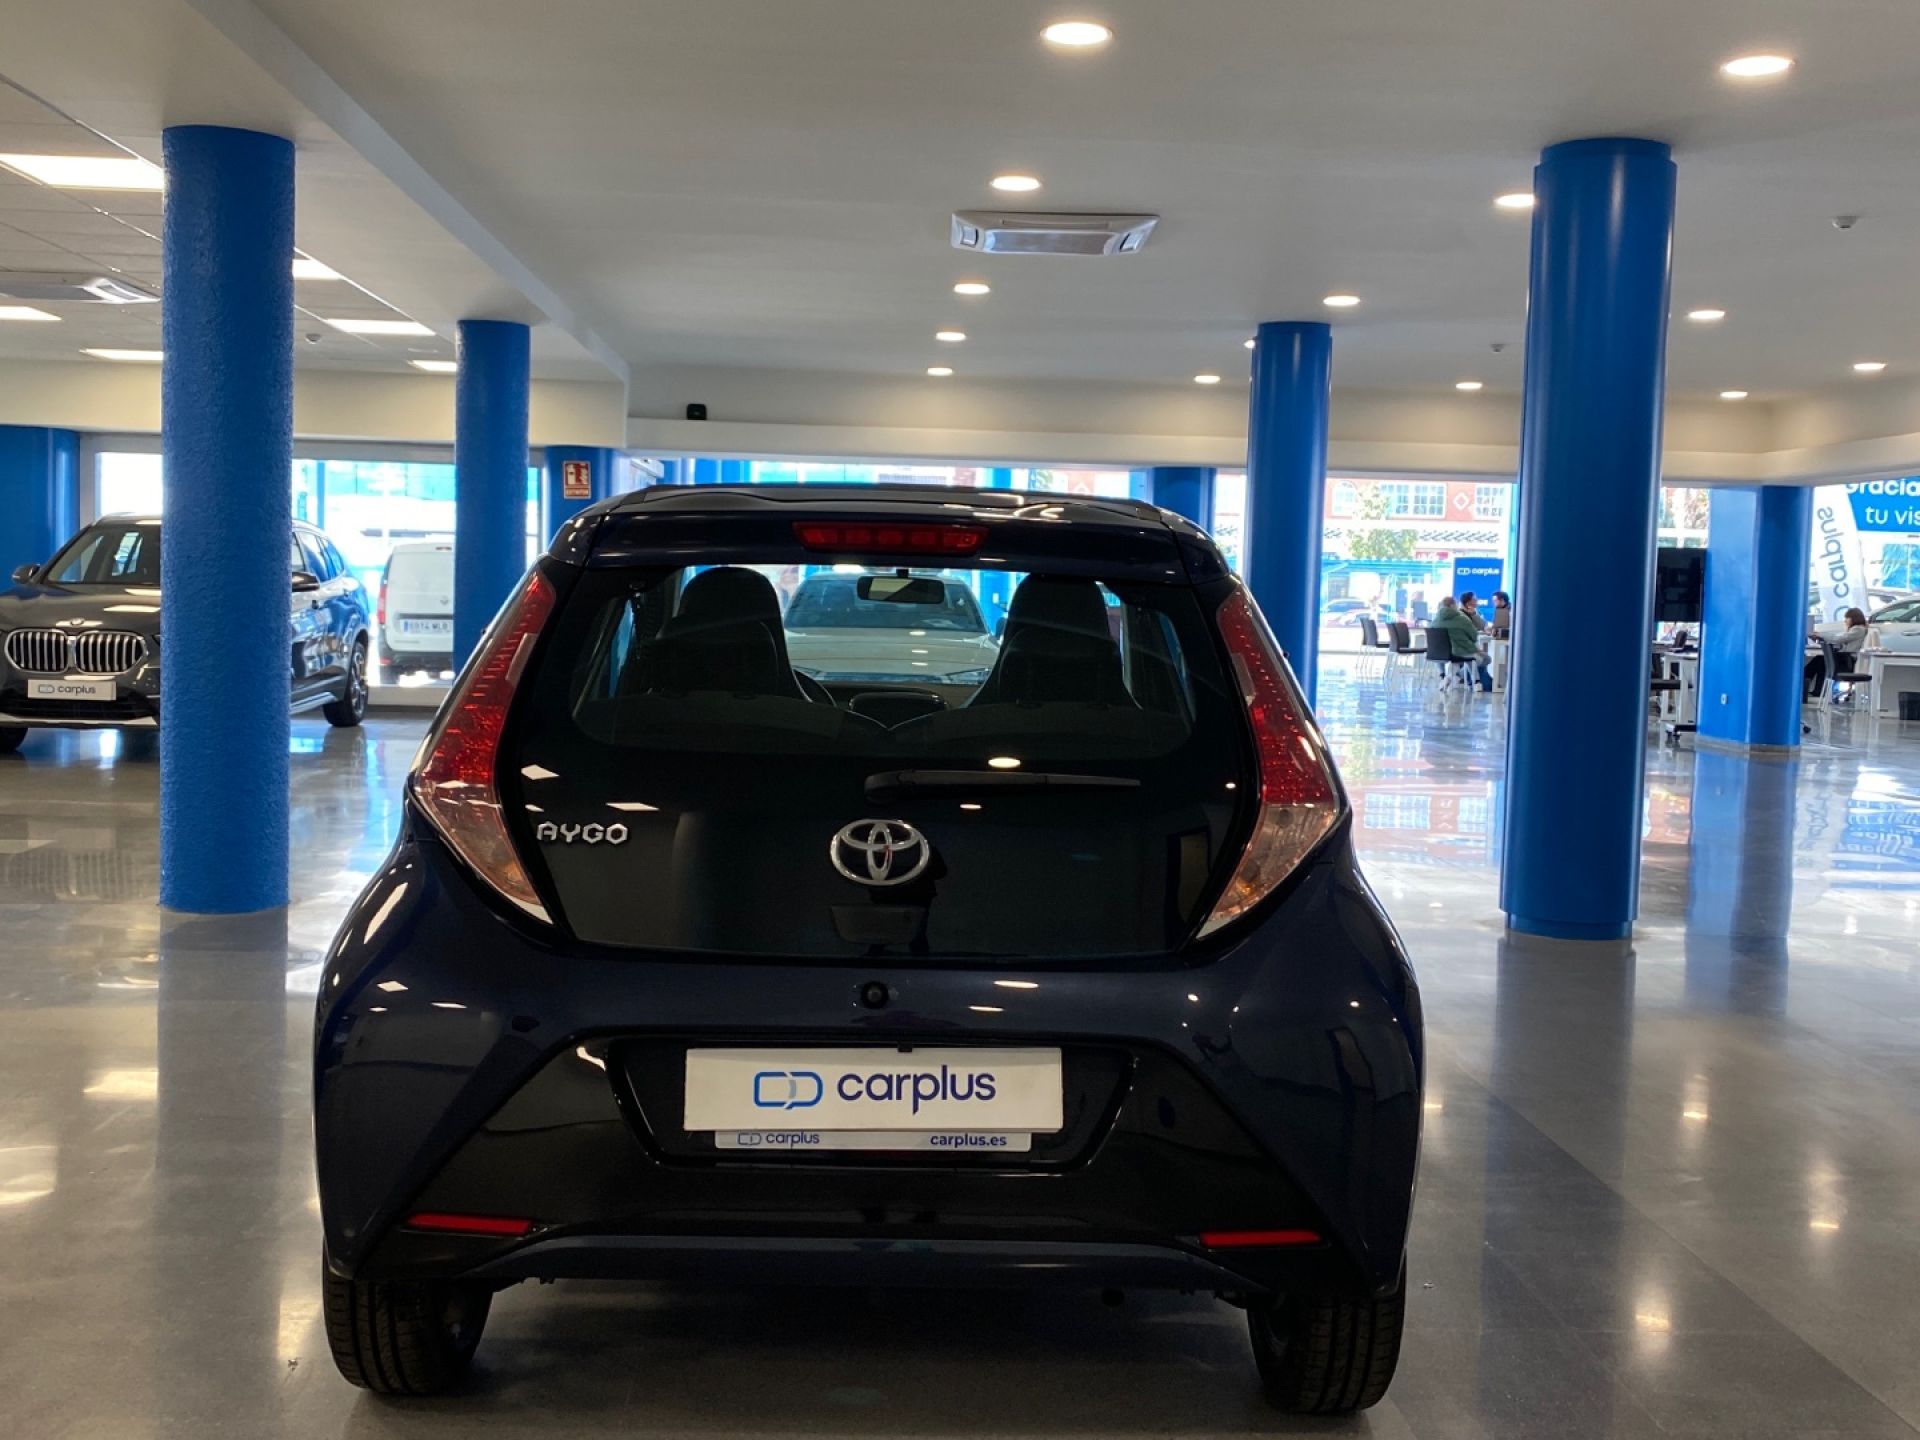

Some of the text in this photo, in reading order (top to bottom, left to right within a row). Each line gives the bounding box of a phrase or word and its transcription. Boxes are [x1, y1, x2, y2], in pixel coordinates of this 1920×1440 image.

[1865, 506, 1888, 524] tu
[58, 684, 97, 697] carplus
[536, 820, 629, 844] AYGO
[837, 1064, 996, 1115] carplus
[766, 1131, 820, 1149] carplus
[930, 1133, 1007, 1148] carplus.es
